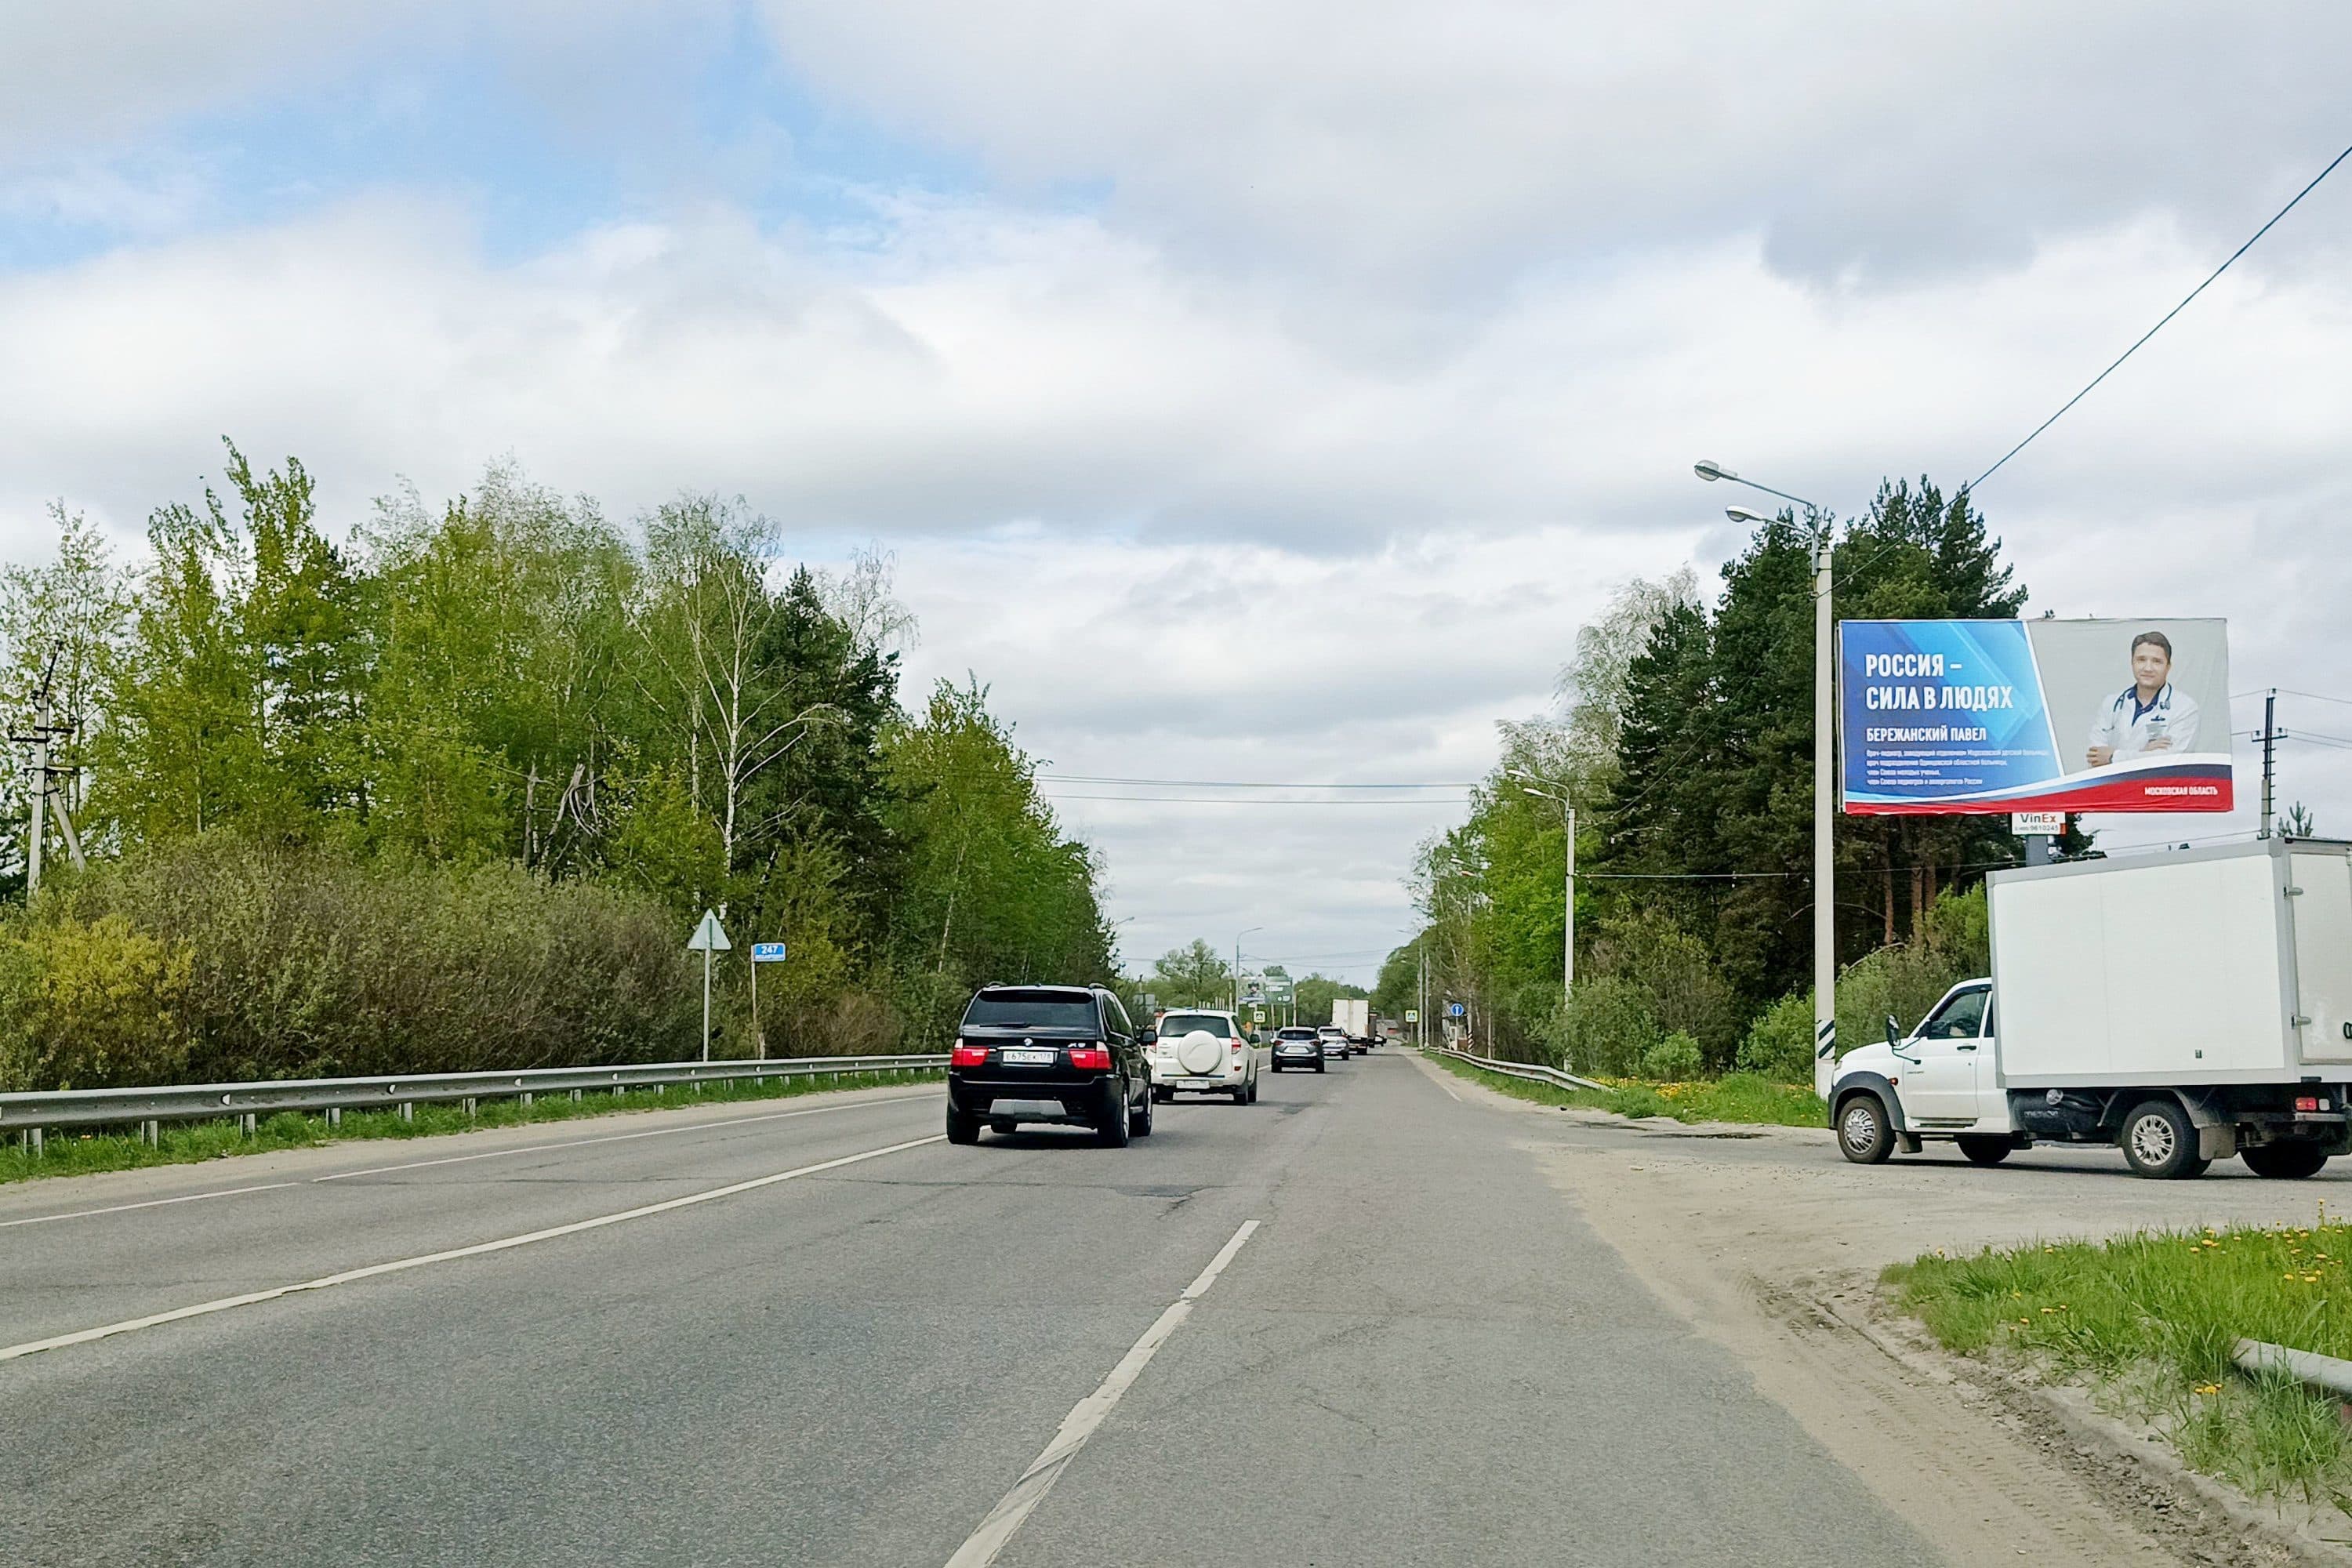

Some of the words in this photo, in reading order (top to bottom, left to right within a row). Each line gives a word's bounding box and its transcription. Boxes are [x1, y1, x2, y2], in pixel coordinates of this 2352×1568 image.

[1866, 654, 1944, 677] РОССИЯ
[1866, 686, 1920, 710] СИЛА
[1923, 686, 1936, 710] В
[1940, 685, 2013, 712] ЛЮДЯХ
[1866, 724, 1948, 742] БЕРЕЖАНСКИЙ
[1951, 727, 1987, 742] ПАВЕЛ
[2188, 786, 2219, 796] ОБЛАСТЬ
[2020, 813, 2056, 823] VinEx
[761, 946, 778, 954] 247
